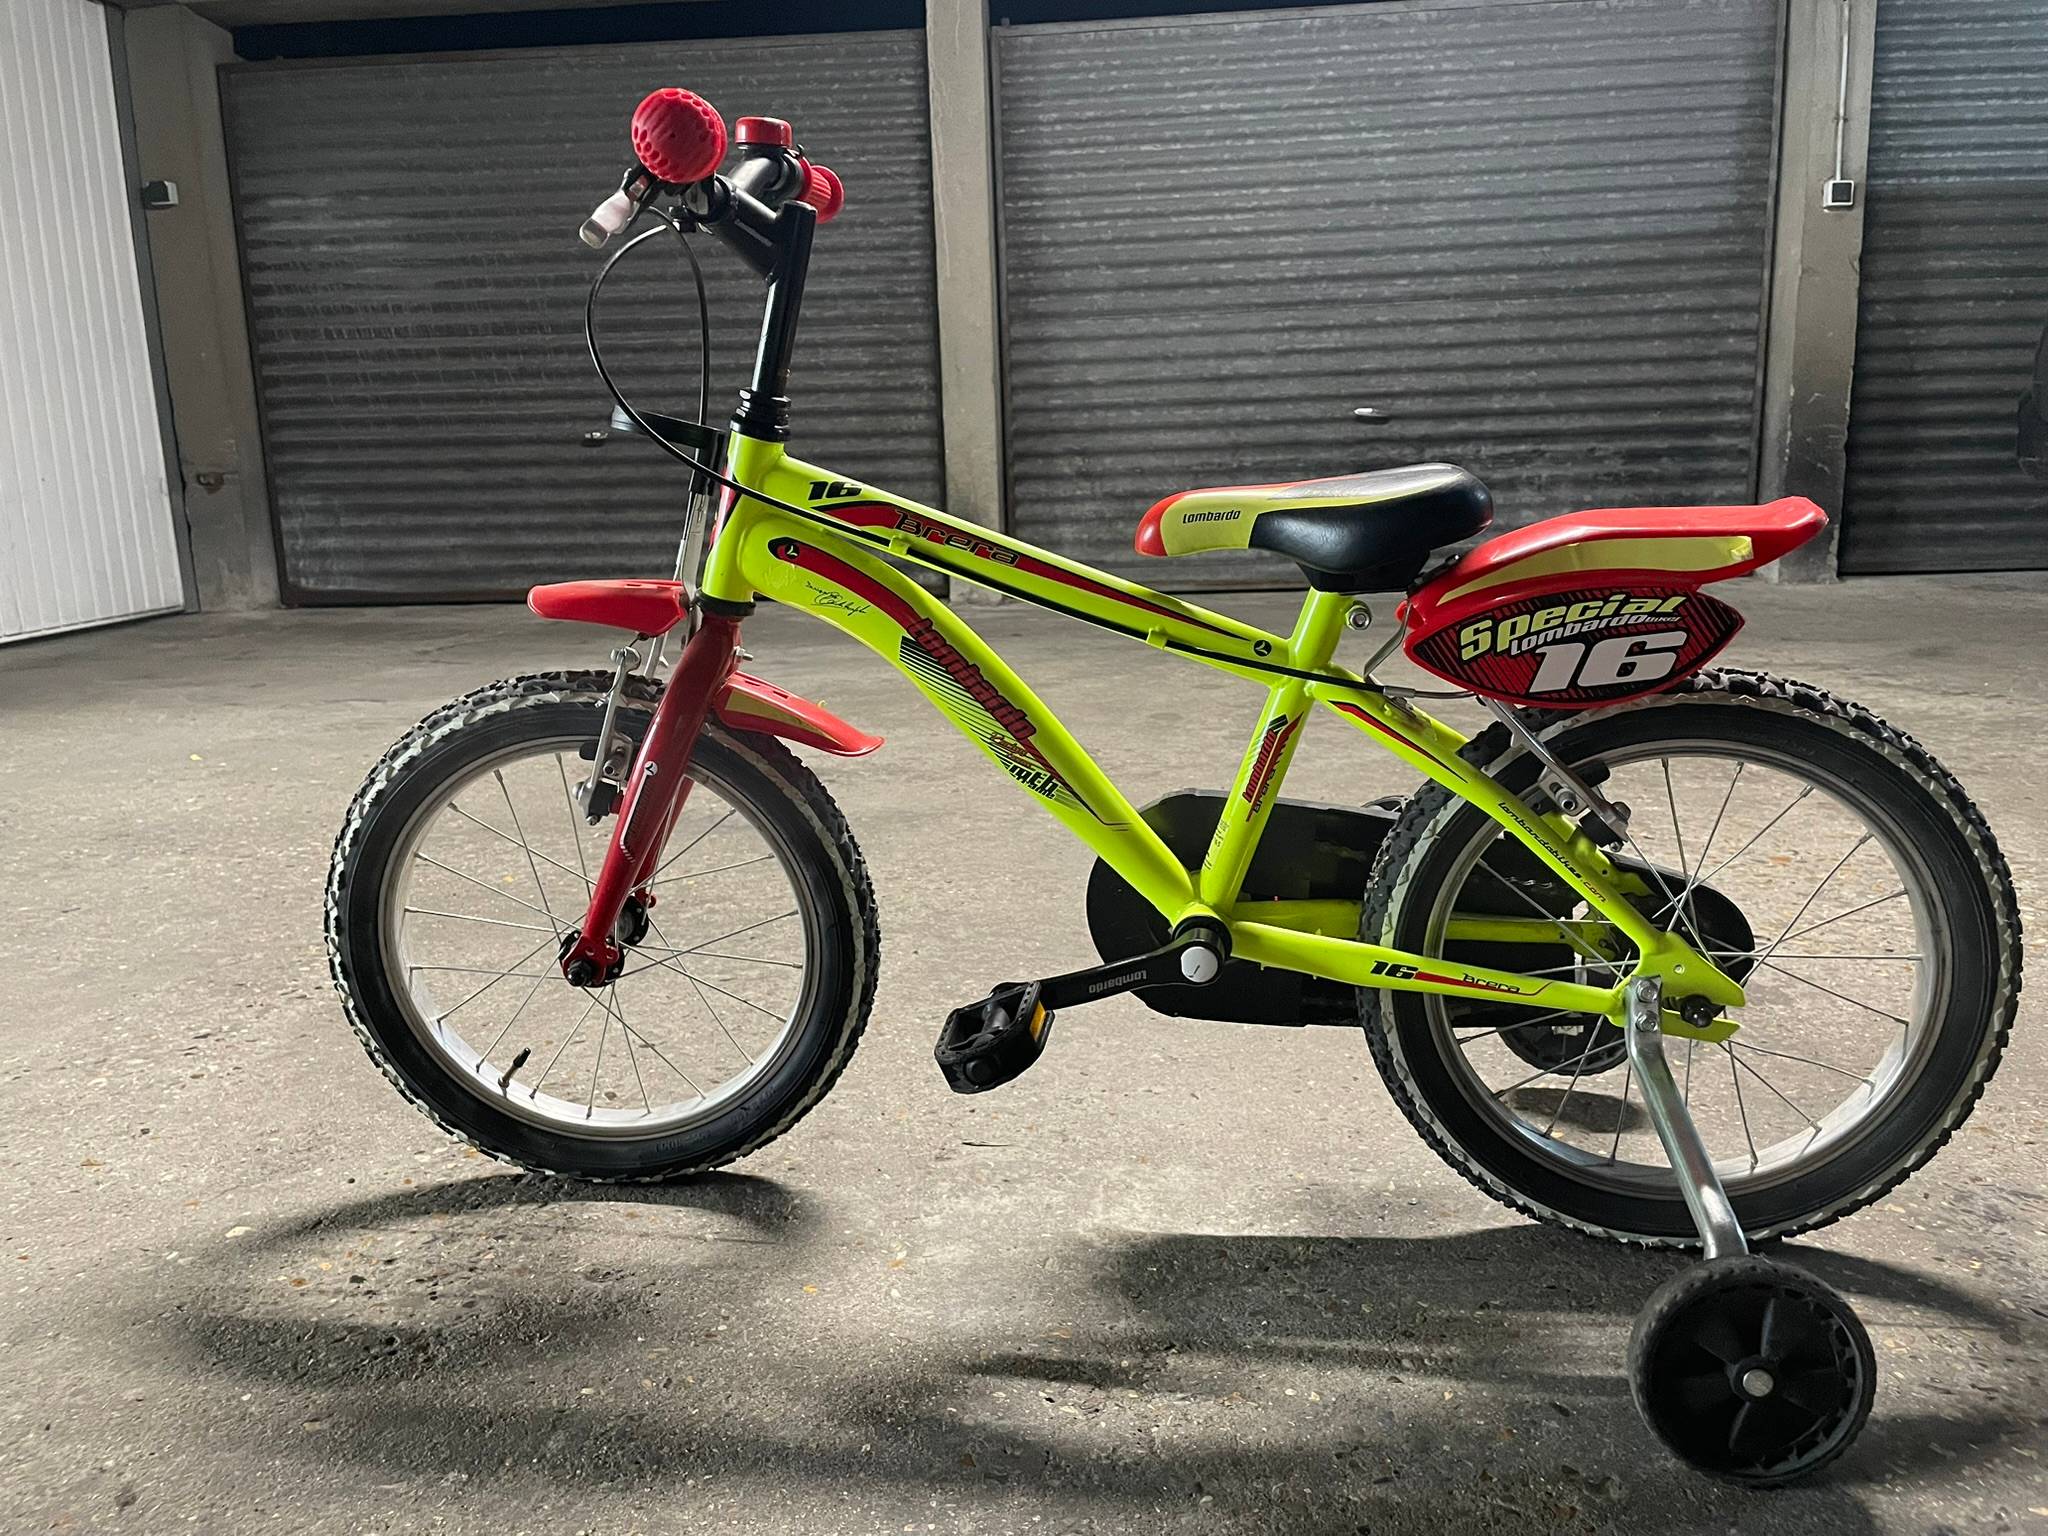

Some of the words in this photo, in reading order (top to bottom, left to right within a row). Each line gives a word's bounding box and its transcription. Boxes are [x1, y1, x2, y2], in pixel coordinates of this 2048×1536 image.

[808, 480, 863, 501] 16
[894, 508, 1020, 567] Brera
[1461, 594, 1687, 662] Special
[1529, 631, 1687, 694] 16
[1370, 960, 1419, 980] 16
[1462, 972, 1521, 994] Brera
